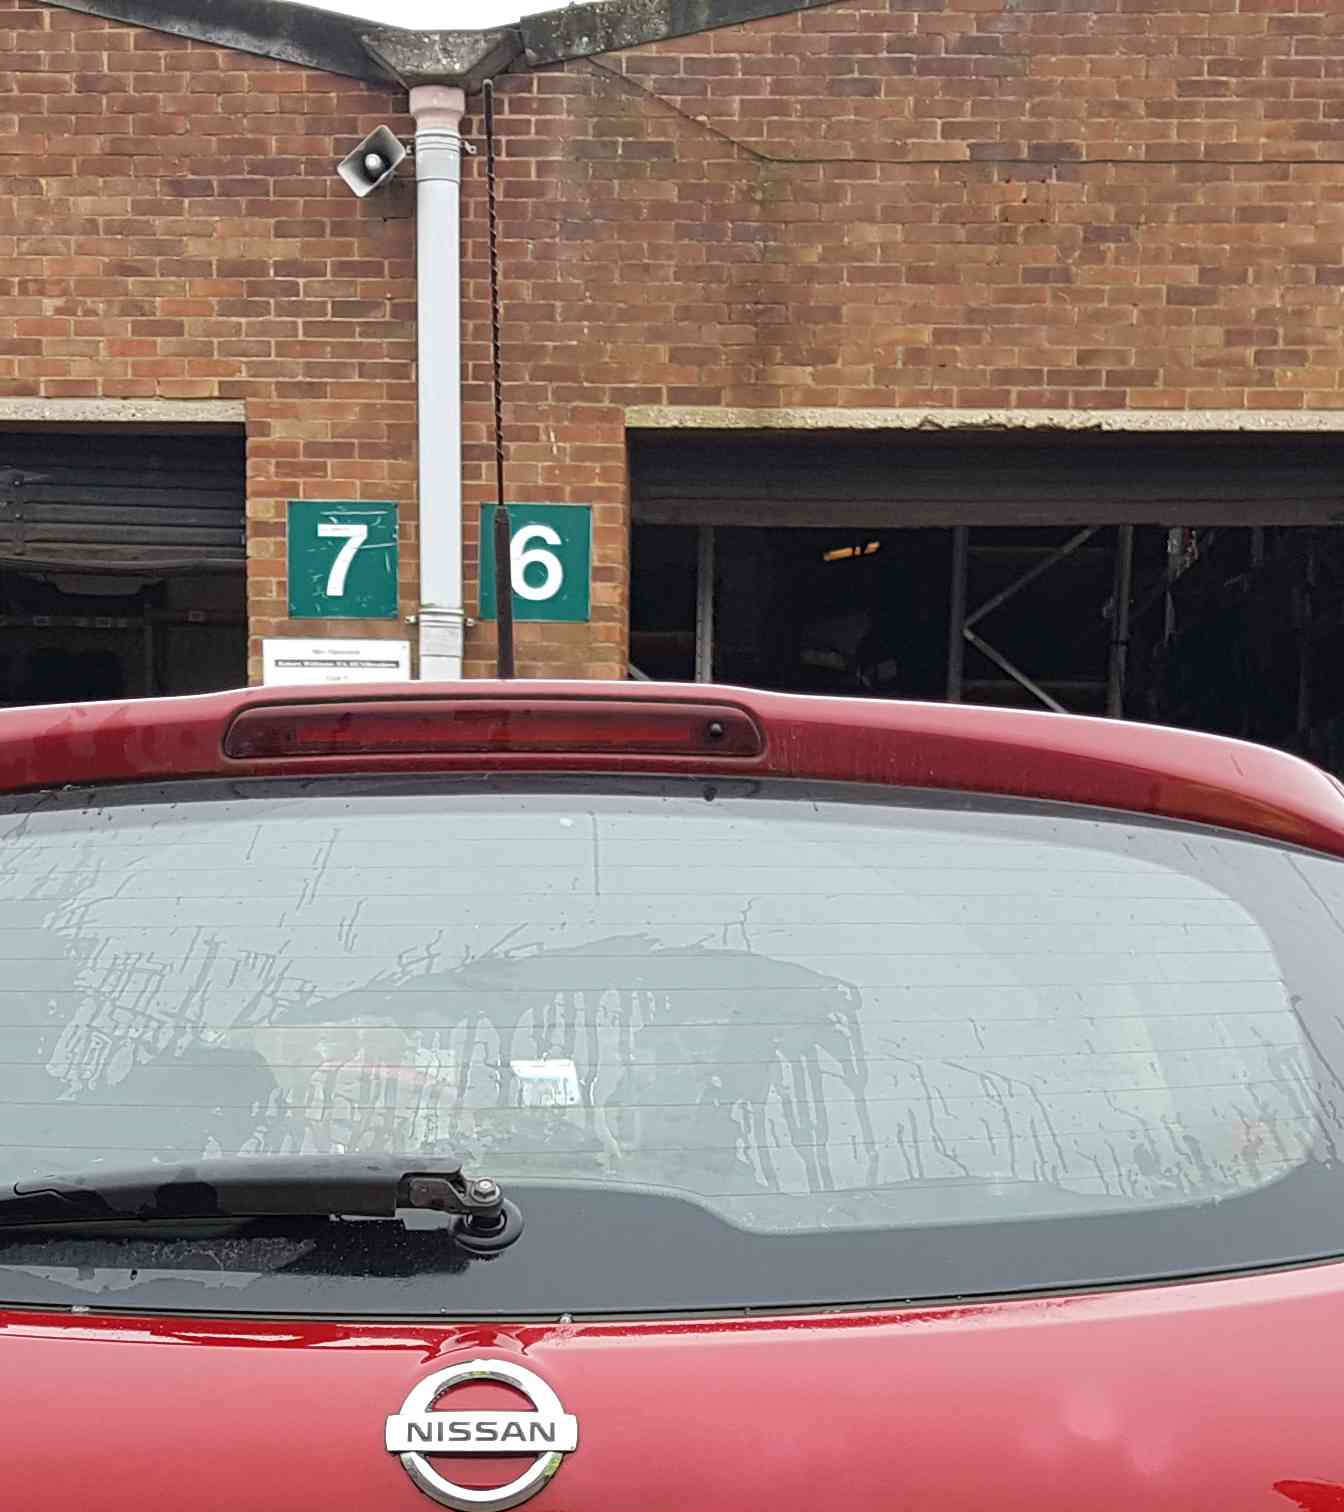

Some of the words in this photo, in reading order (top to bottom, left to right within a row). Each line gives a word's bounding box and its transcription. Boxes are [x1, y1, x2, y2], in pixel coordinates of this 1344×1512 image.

[317, 523, 368, 597] 7
[510, 524, 564, 601] 6
[407, 1421, 556, 1443] NISSAN
